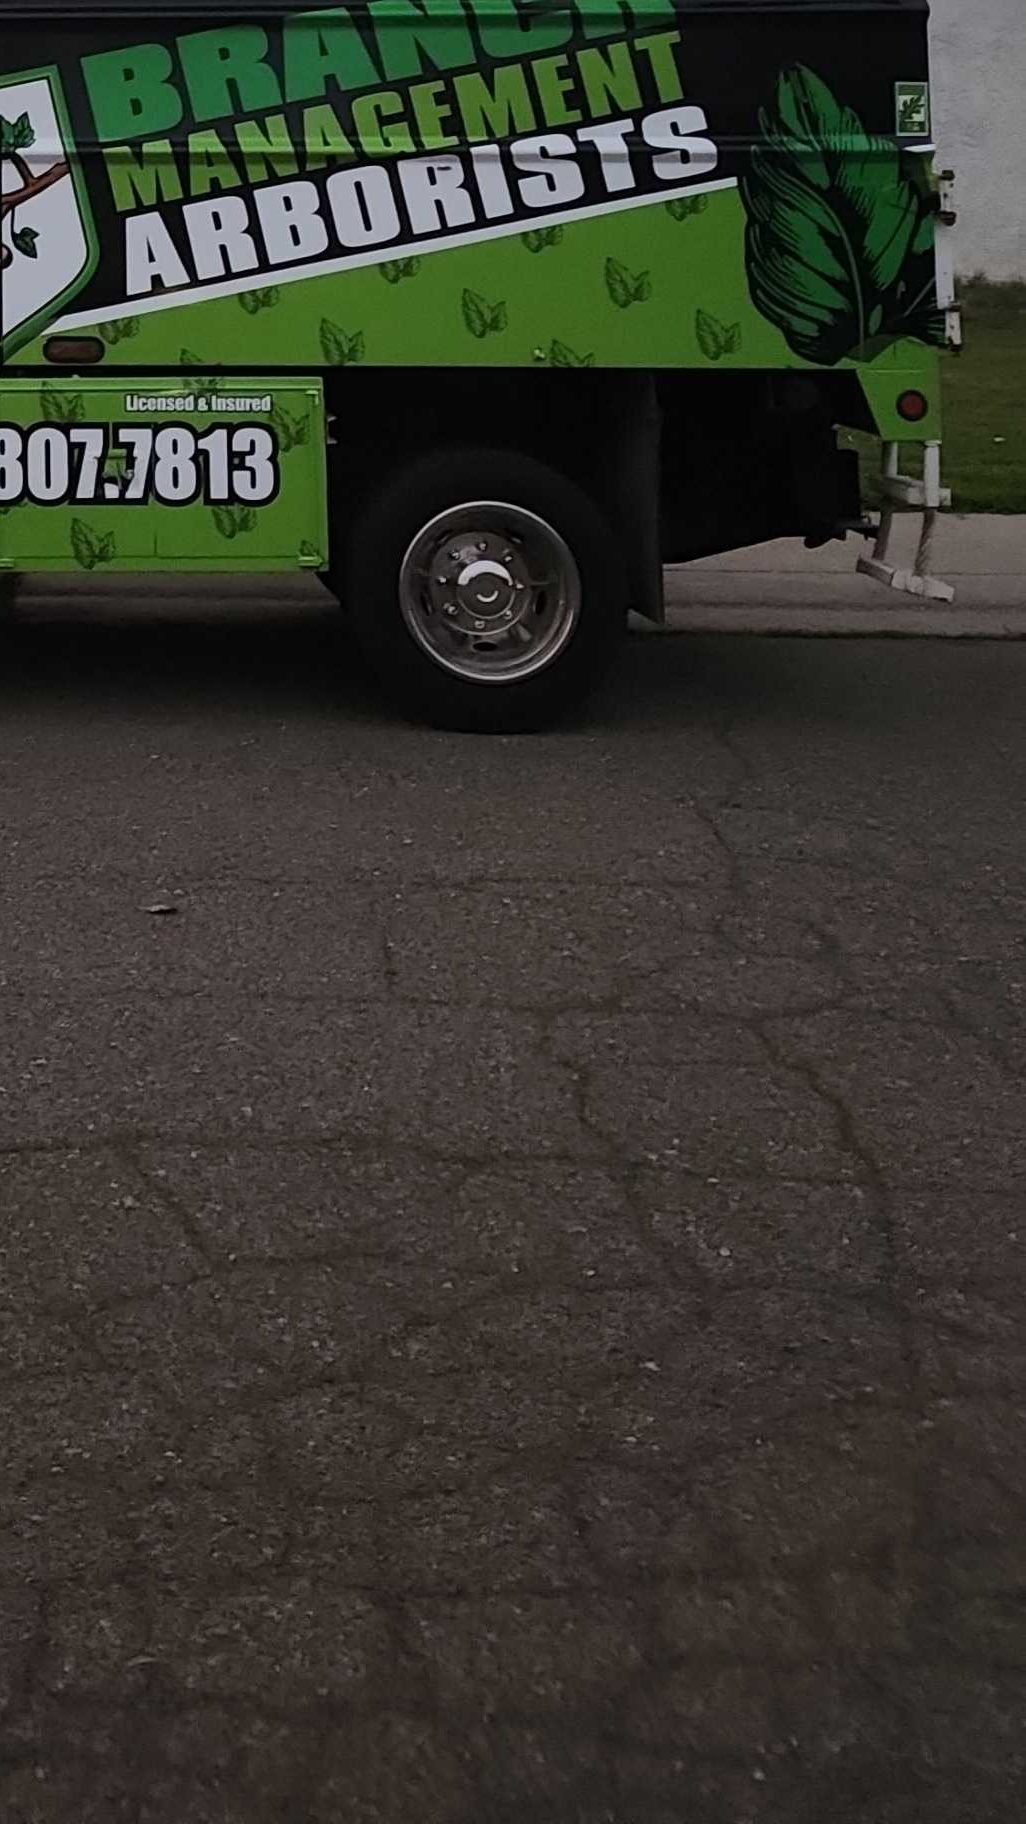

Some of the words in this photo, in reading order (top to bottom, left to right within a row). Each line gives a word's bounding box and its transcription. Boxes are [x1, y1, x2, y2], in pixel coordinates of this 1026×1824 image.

[101, 30, 685, 212] MANAGEMENT
[124, 105, 718, 296] ARBORISTS
[126, 394, 195, 412] Licensed
[197, 396, 209, 412] &
[211, 394, 272, 412] Insured
